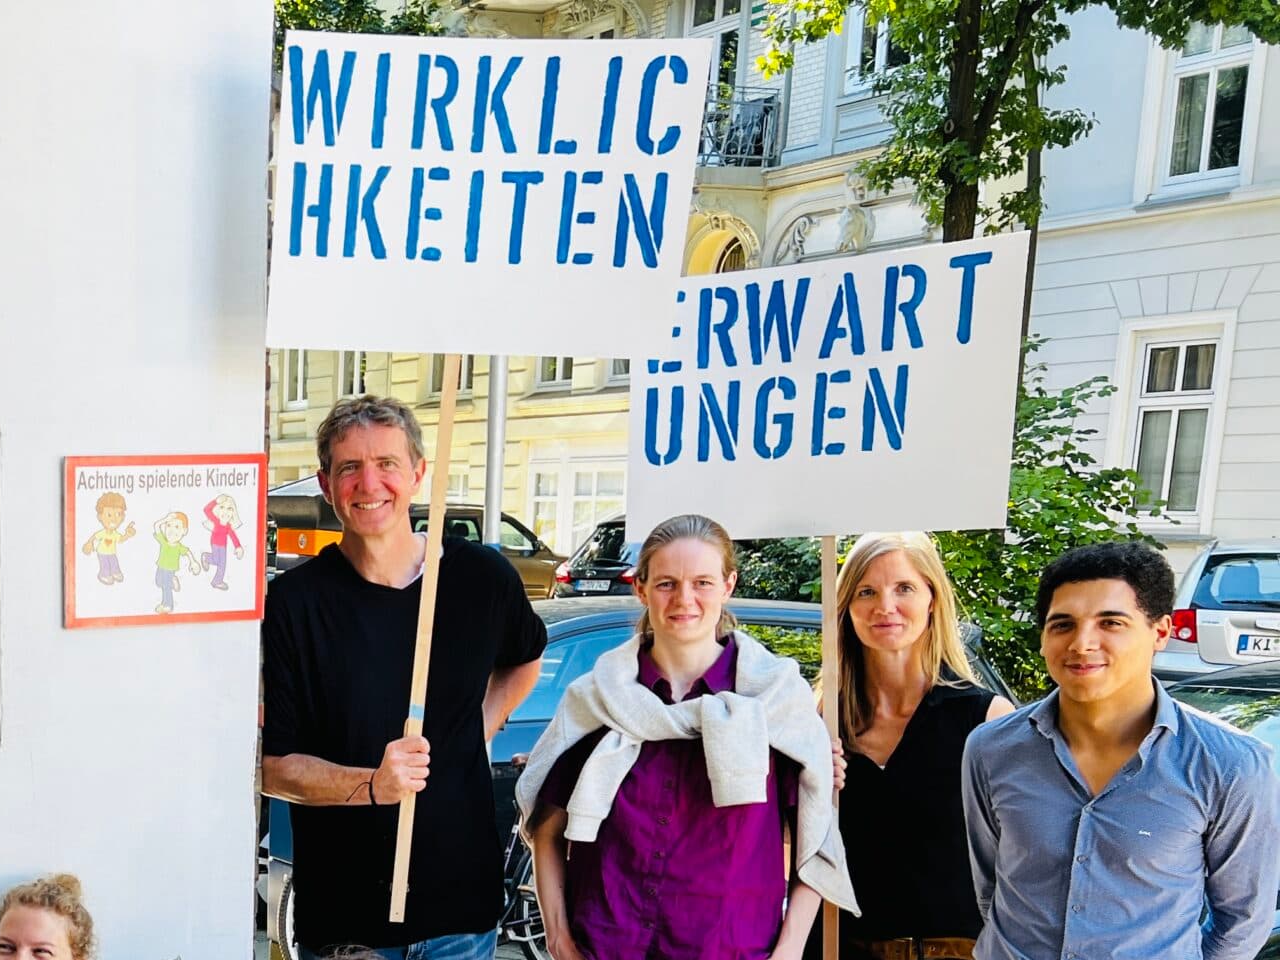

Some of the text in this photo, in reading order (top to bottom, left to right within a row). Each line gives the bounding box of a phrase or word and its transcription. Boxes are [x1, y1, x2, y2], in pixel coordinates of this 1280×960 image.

[288, 44, 690, 156] WIRKLIC
[288, 161, 670, 269] HKEITEN
[643, 363, 910, 467] UNGEN
[77, 470, 135, 493] Achtung
[138, 469, 202, 493] spielende
[206, 468, 249, 488] Kinder
[1252, 638, 1271, 651] KI
